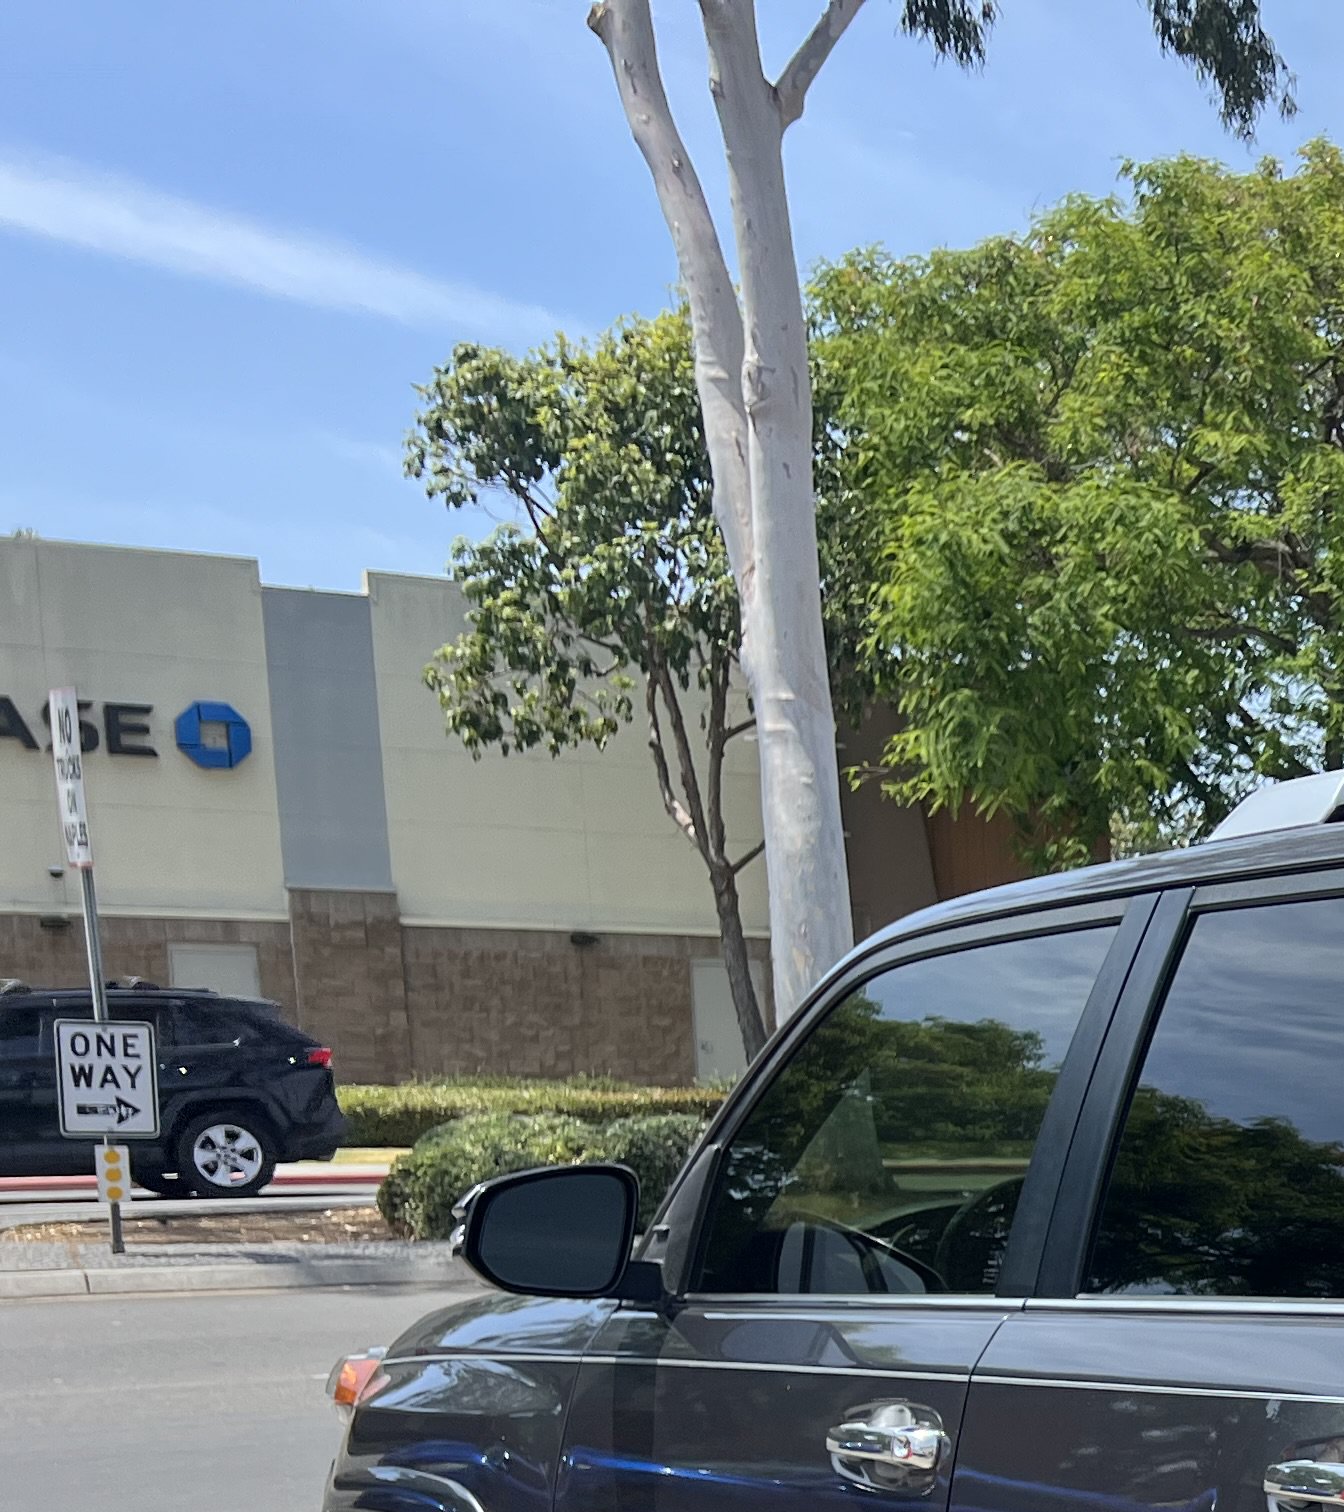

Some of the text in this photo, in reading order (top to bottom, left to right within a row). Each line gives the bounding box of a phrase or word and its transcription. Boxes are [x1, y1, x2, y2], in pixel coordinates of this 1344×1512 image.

[57, 707, 72, 744] NO
[70, 1031, 141, 1058] ONE
[69, 1063, 142, 1089] WAY
